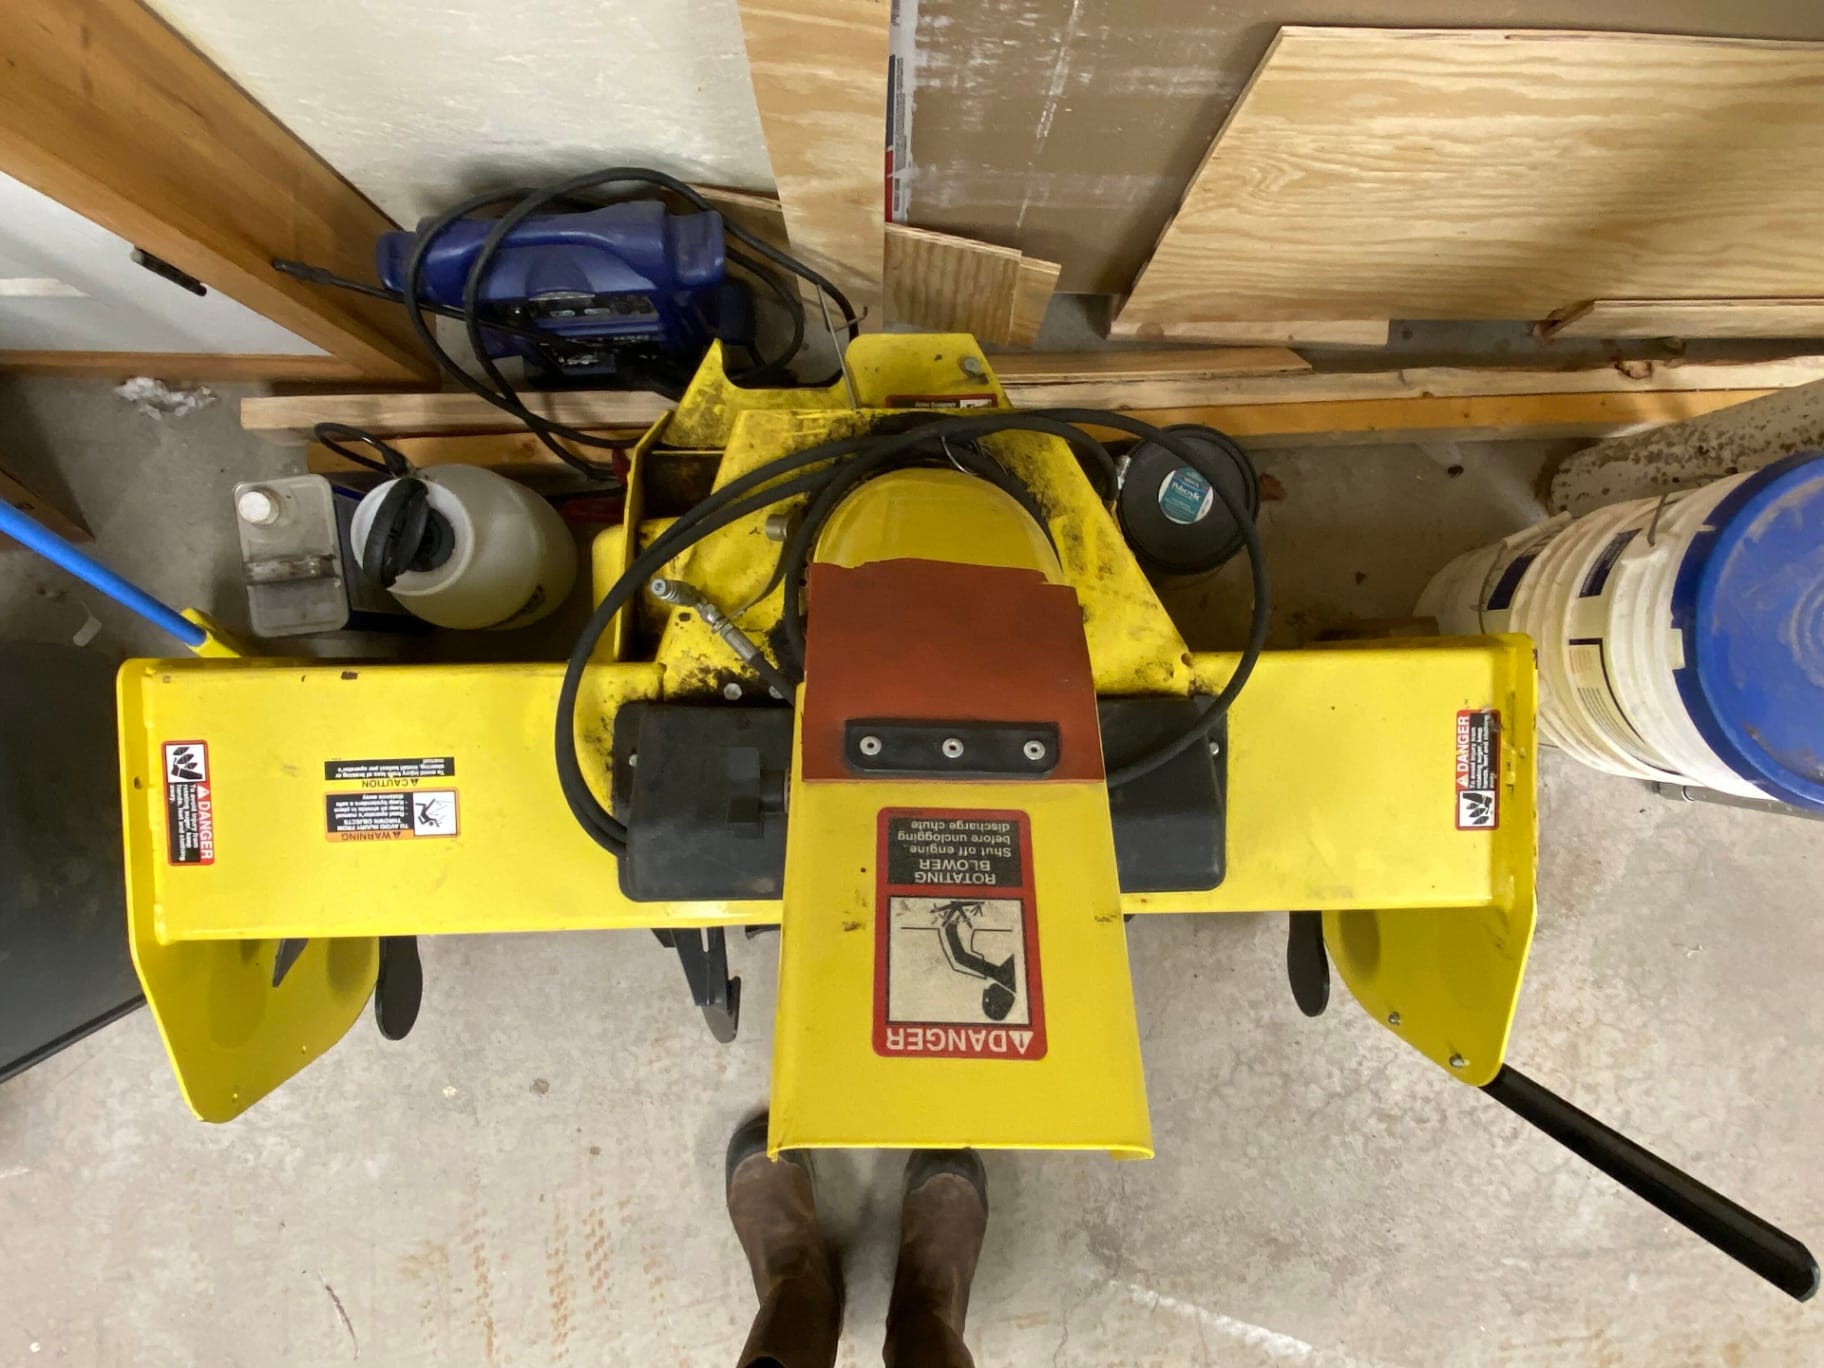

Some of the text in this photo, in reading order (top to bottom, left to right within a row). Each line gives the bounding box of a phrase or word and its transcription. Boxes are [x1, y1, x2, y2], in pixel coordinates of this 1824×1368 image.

[1456, 716, 1469, 772] DANGER
[361, 779, 408, 788] CAUTION
[199, 801, 213, 859] DANGER
[911, 820, 1010, 834] discharge chute
[341, 832, 391, 841] WARNING
[897, 831, 1010, 846] before unclogging
[909, 843, 1011, 858] Shut off engine
[919, 859, 990, 871] BLOWER
[914, 871, 996, 885] ROTATING
[886, 1028, 1007, 1052] DANGER
